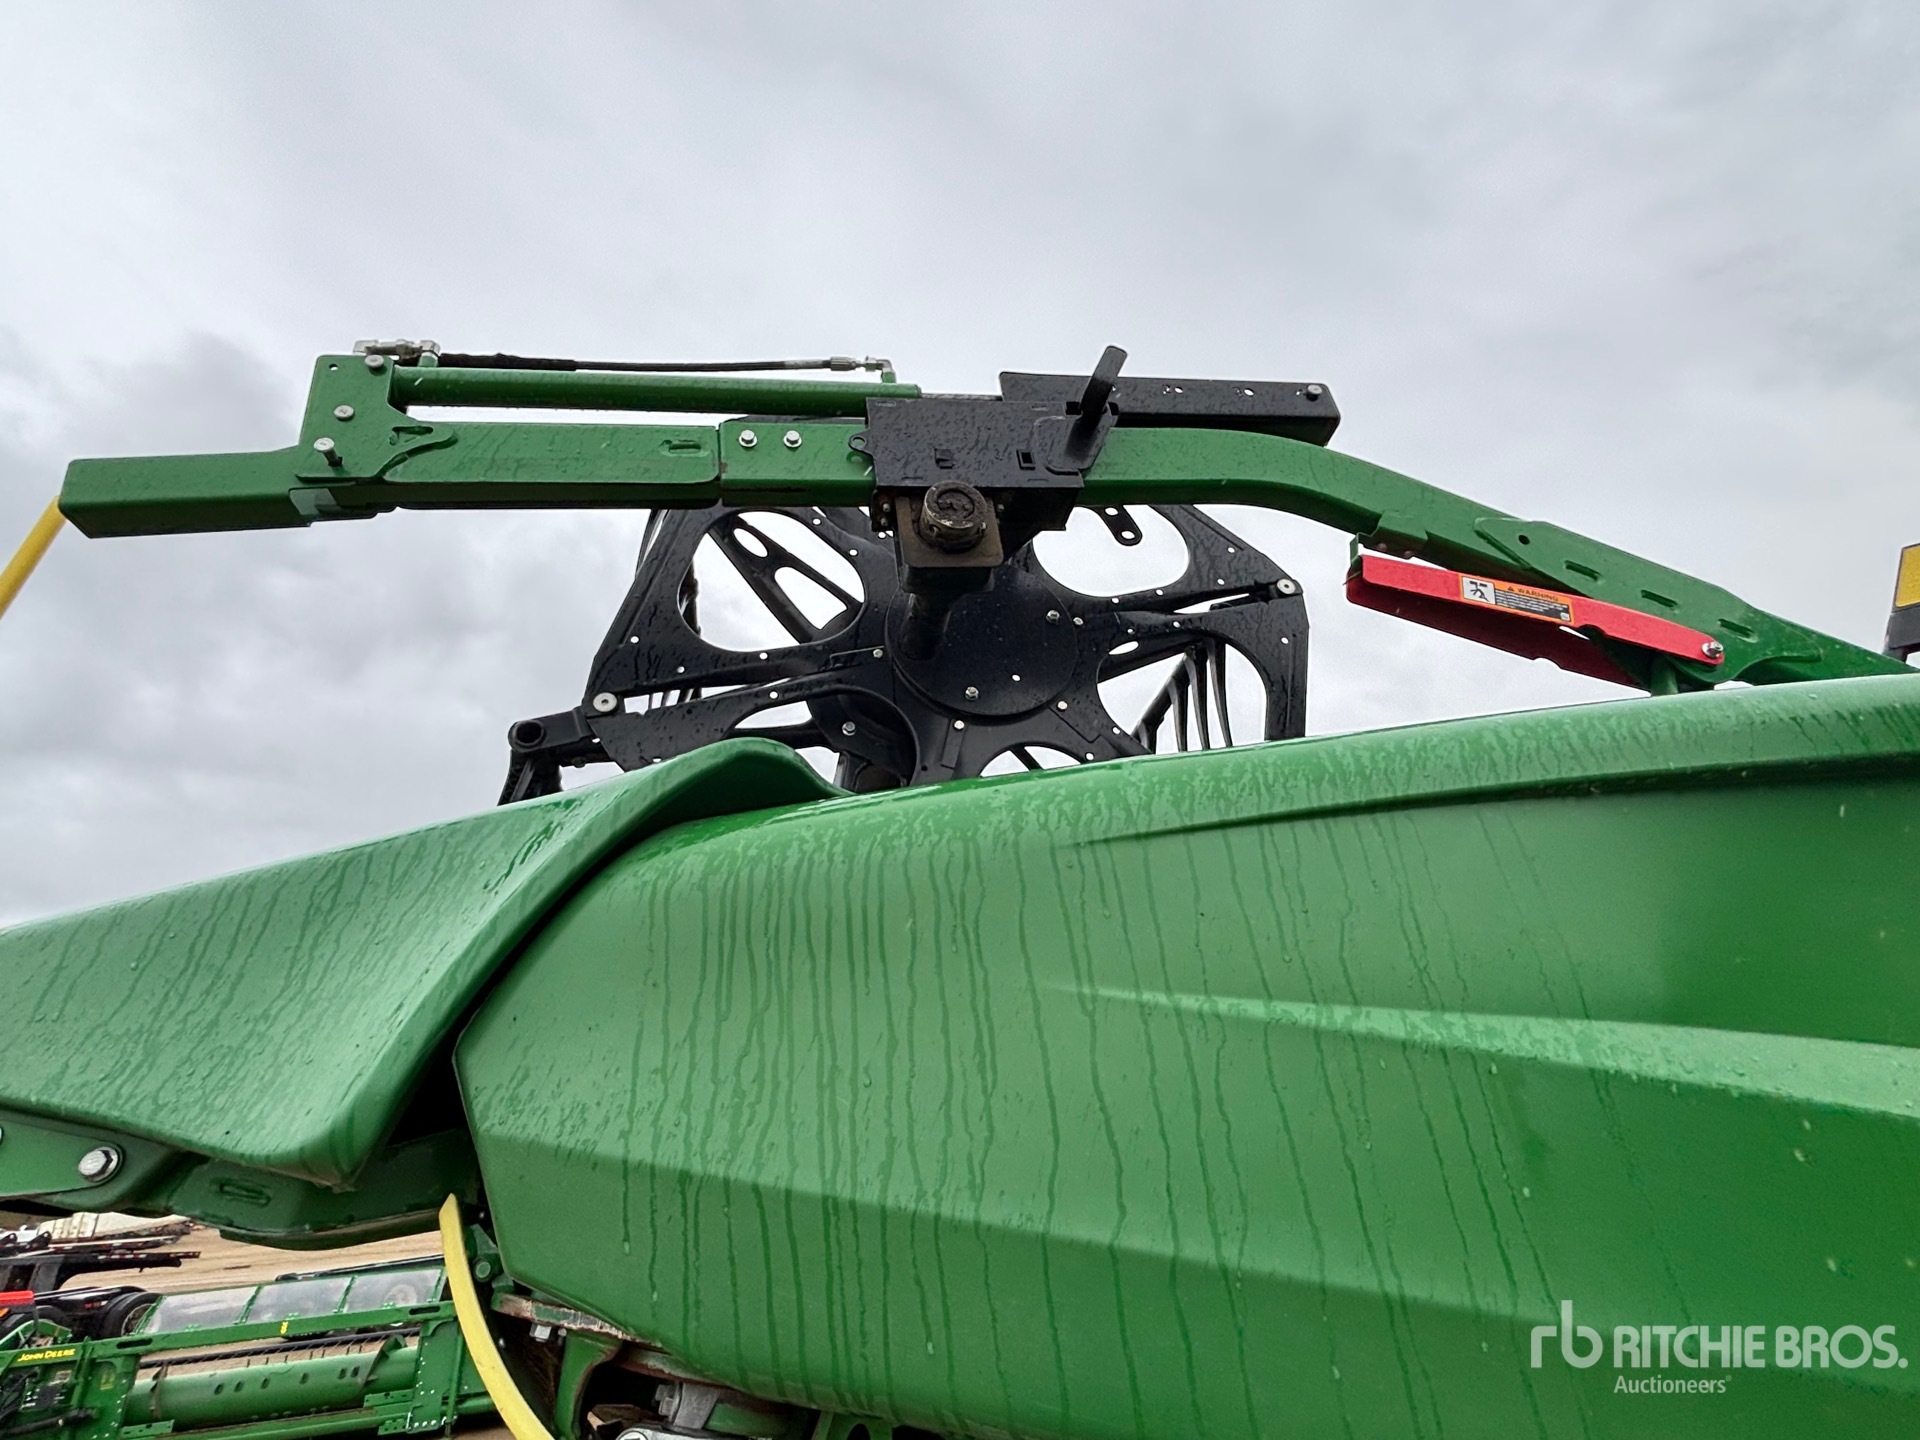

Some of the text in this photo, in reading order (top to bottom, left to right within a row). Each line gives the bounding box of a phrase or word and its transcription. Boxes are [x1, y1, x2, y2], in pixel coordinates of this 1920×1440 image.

[1517, 587, 1559, 602] WARNING
[17, 1348, 76, 1362] JOHN DEERE
